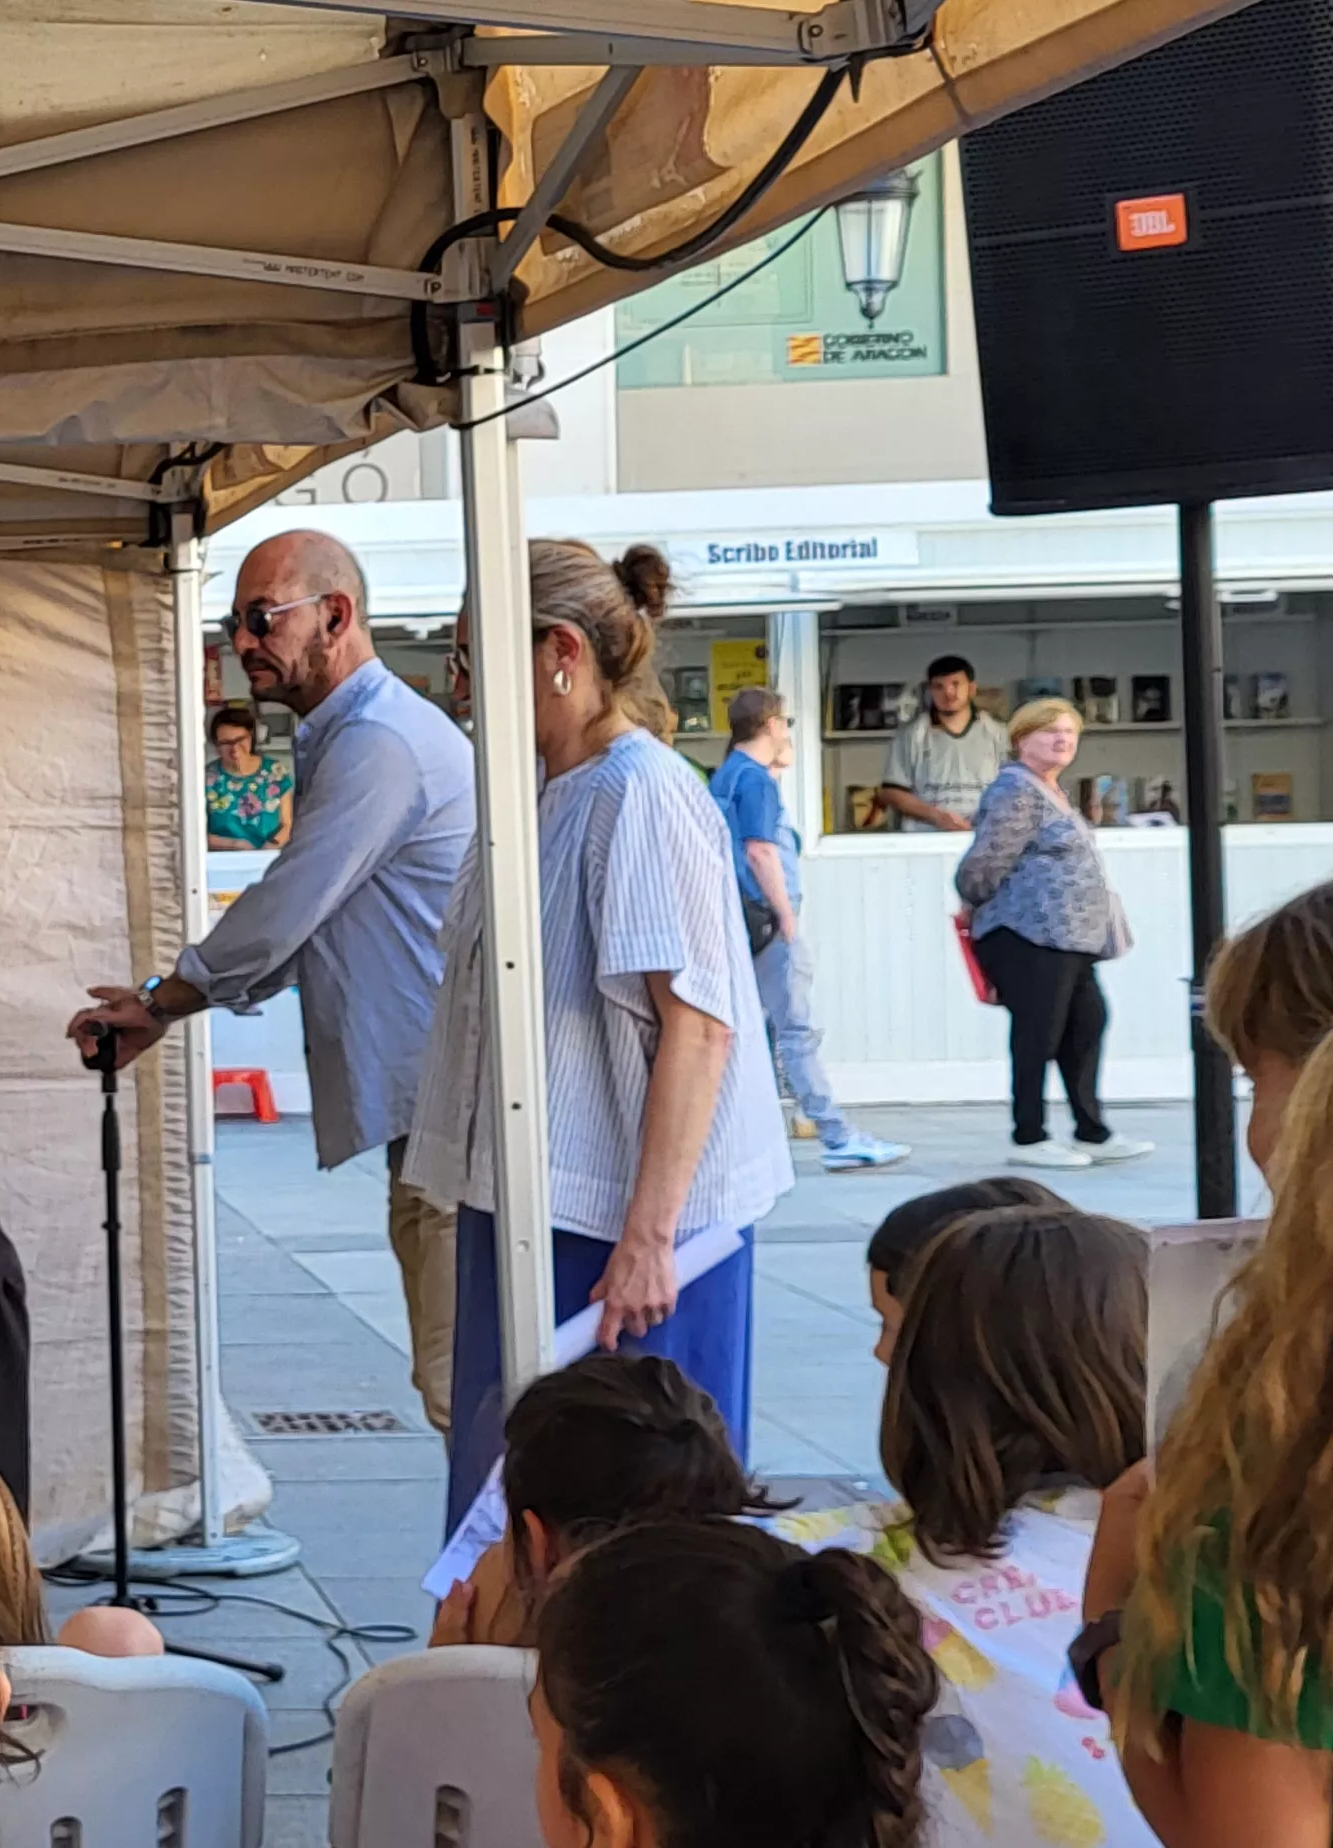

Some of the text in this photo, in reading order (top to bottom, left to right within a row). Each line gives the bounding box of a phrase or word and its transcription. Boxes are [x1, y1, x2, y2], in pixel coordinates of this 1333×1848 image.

[1128, 208, 1177, 237] JBL
[822, 331, 914, 348] GOBIERNO
[823, 351, 846, 364] DE
[707, 536, 878, 564] Scribo Editorial
